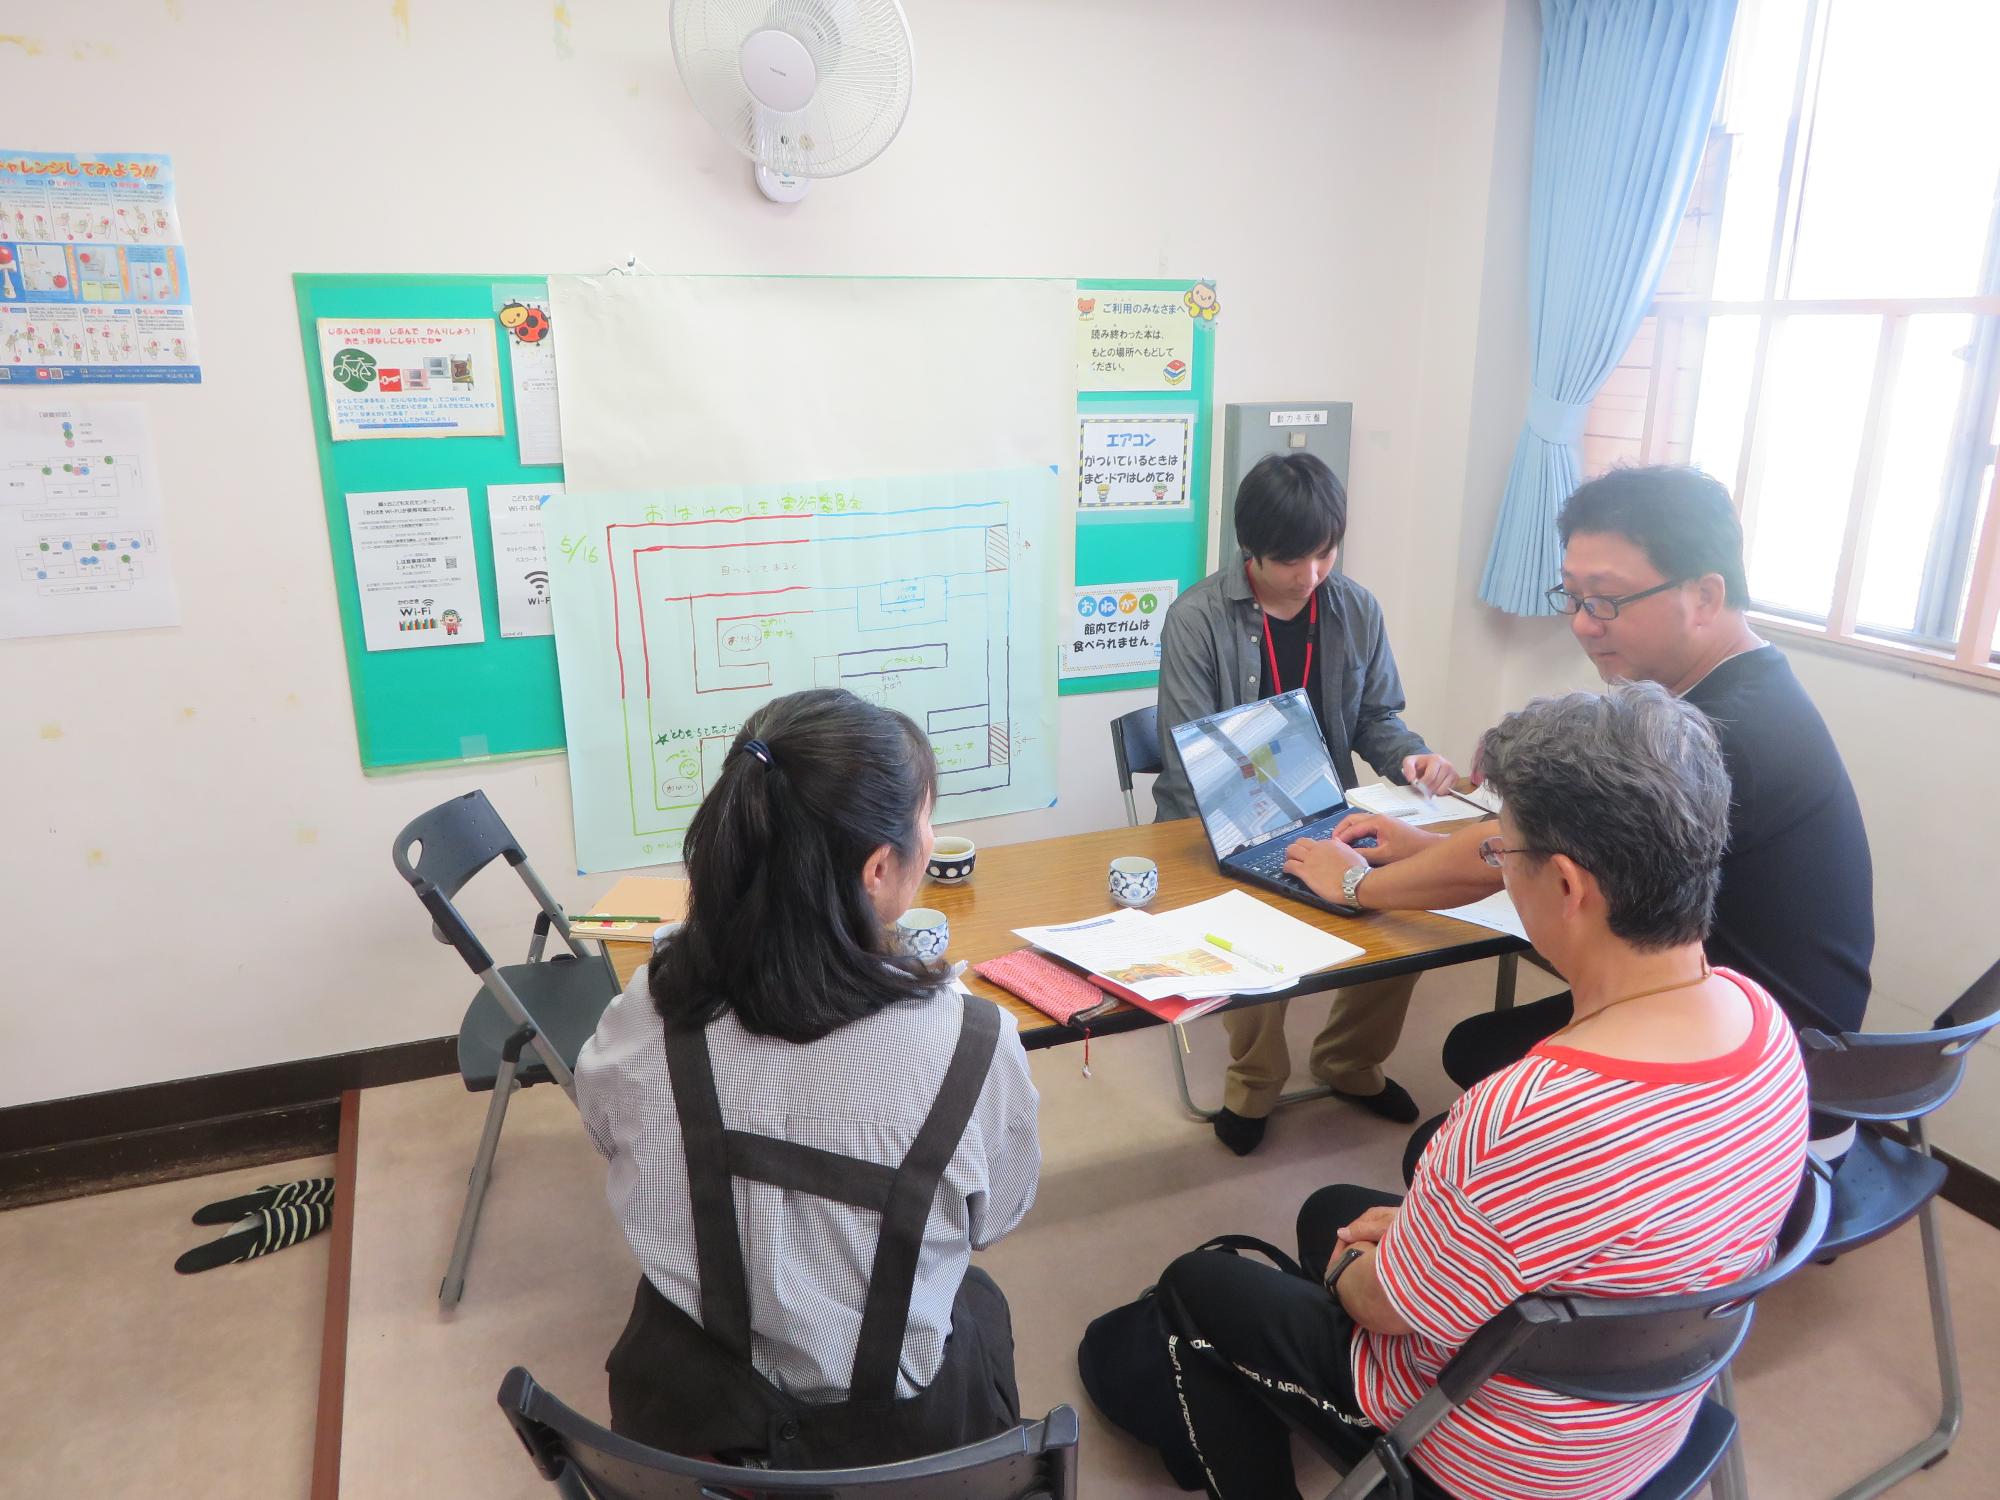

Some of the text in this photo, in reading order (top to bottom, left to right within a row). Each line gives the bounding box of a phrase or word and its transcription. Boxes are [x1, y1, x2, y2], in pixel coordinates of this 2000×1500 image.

[1103, 302, 1186, 315] ご利用のみなさまへ
[328, 327, 381, 335] じぶんのものは
[389, 327, 420, 335] じぶんで
[1091, 328, 1164, 341] 読み終わった本は、
[1091, 346, 1174, 358] もとの場所へもどして
[1277, 413, 1320, 424] 動力手元盤
[1106, 433, 1156, 448] エアコン
[1084, 455, 1178, 467] がついているときは
[1084, 471, 1174, 485] まど・ドアはしめてね
[644, 492, 864, 523] おばけやしき 実行委員会
[559, 534, 599, 564] 5/16
[398, 598, 420, 606] かわさき
[1079, 595, 1157, 616] おねがい
[400, 606, 431, 617] Wi-Fi
[1084, 619, 1150, 636] 館内でガムは
[1073, 636, 1155, 653] 食べられません。
